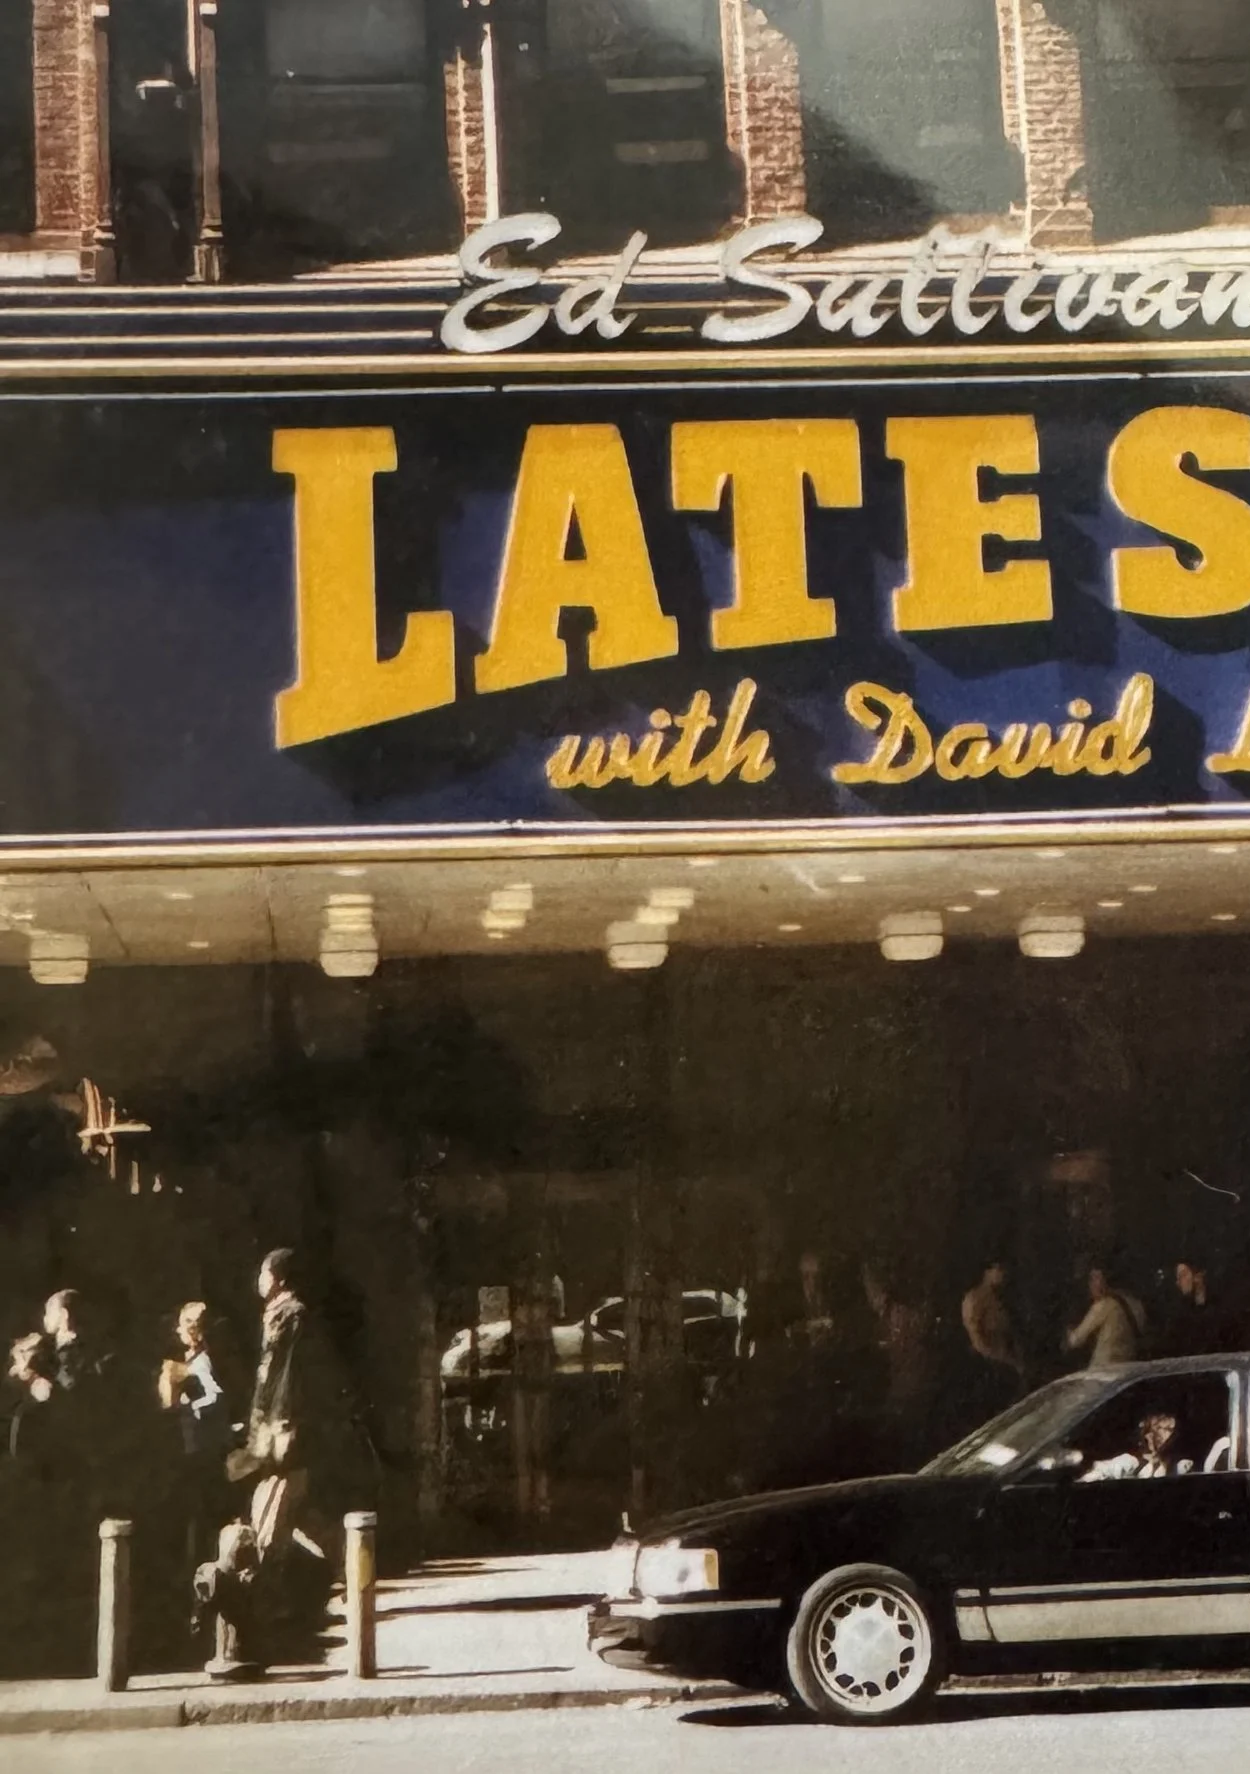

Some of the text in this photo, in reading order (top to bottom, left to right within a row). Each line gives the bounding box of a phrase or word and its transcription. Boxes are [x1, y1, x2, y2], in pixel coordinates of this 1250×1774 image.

[440, 211, 648, 354] Ed
[271, 412, 1055, 750] LATE
[544, 677, 777, 790] with
[830, 671, 1154, 786] David
